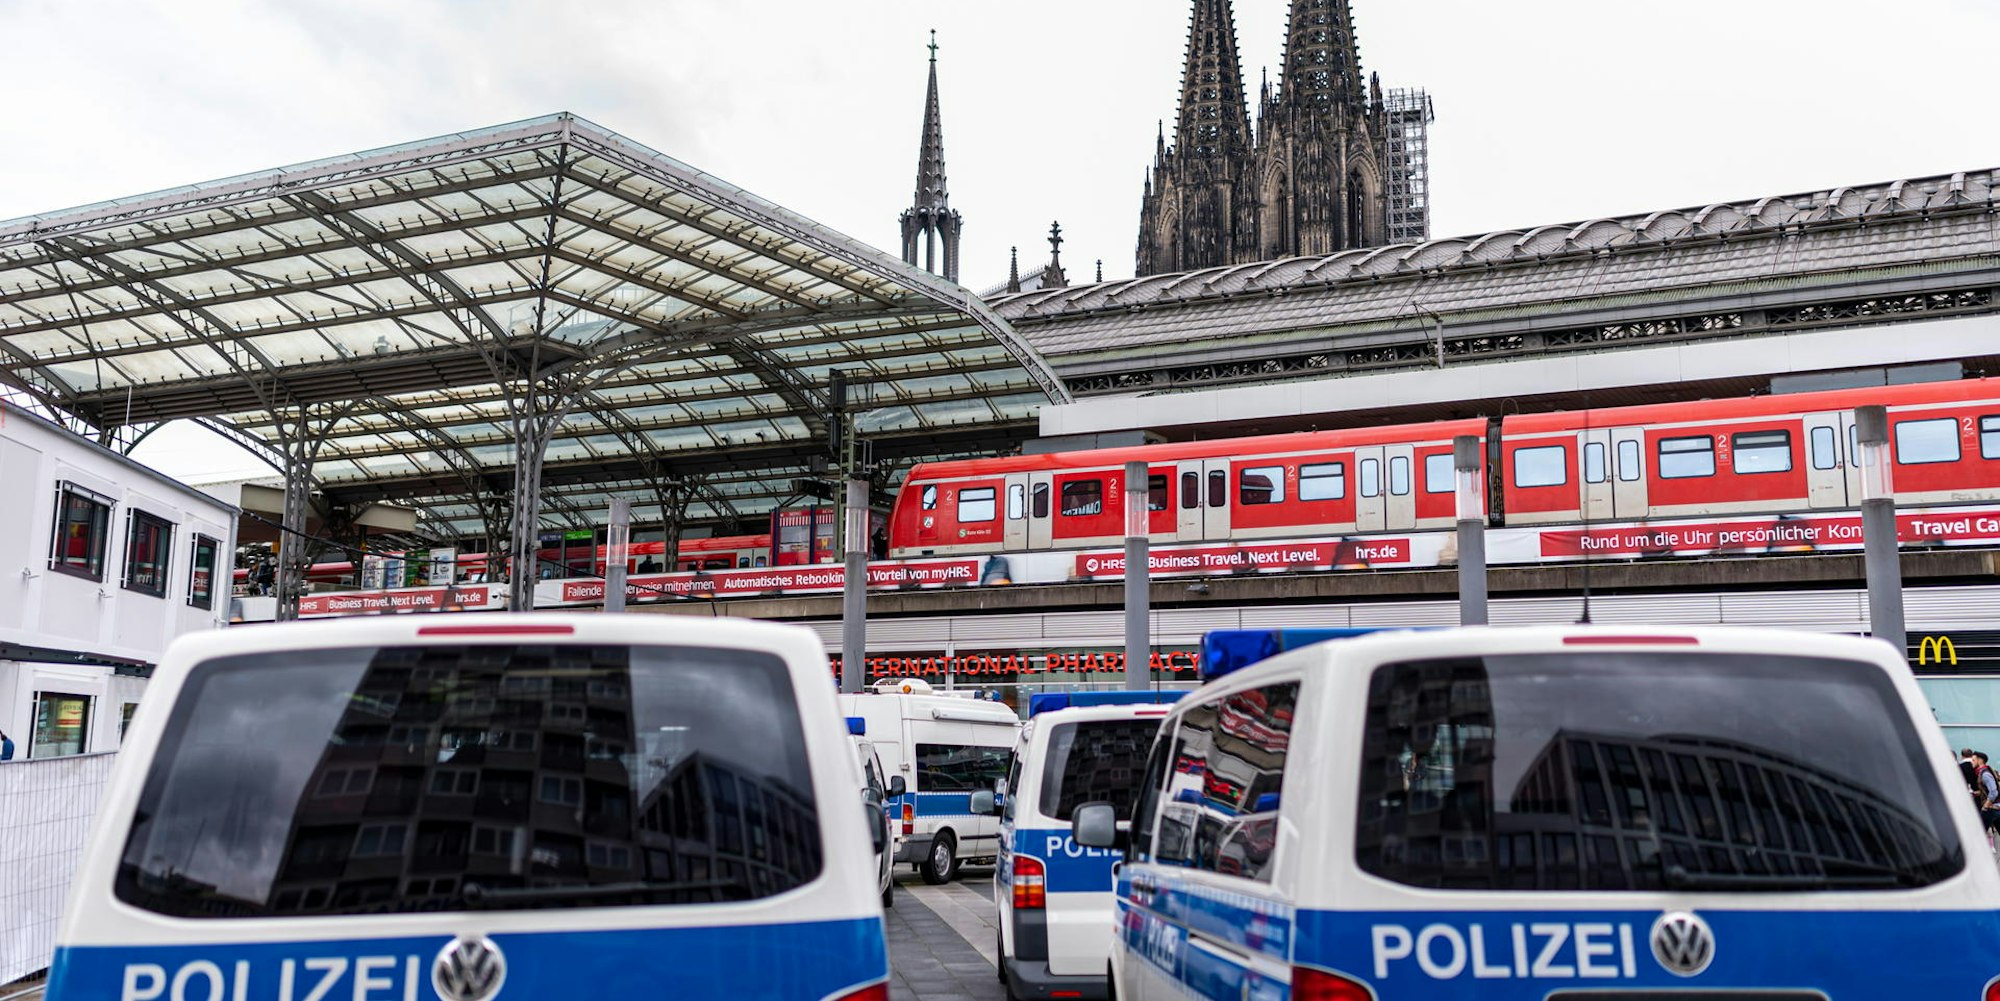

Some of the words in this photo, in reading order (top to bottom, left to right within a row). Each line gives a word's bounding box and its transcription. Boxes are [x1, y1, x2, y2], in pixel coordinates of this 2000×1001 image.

[1963, 417, 1973, 431] 2
[1718, 434, 1727, 448] 2
[1287, 465, 1295, 477] 2
[1109, 478, 1117, 490] 2
[946, 490, 953, 501] 2
[1580, 534, 1619, 549] Rund
[1625, 535, 1650, 547] um
[1654, 531, 1679, 546] die
[1683, 529, 1714, 545] Uhr
[1719, 523, 1821, 546] persönlicher
[1911, 519, 1970, 536] Travel
[1101, 559, 1126, 570] HRS
[1148, 554, 1199, 568] Business
[1203, 551, 1245, 566] Travel.
[1248, 551, 1279, 564] Next
[1282, 548, 1320, 562] Level.
[1355, 545, 1398, 559] hrs.de
[568, 585, 602, 597] Fallende
[664, 579, 717, 592] mitnehmen.
[724, 575, 793, 589] Automatisches
[796, 571, 845, 585] Rebookin
[873, 568, 907, 581] Vorteil
[909, 569, 929, 579] von
[931, 566, 973, 580] myHRS.
[300, 601, 317, 610] HRS
[329, 599, 362, 609] Business
[363, 597, 389, 608] Travel.
[391, 596, 410, 606] Next
[411, 594, 435, 605] Level.
[455, 592, 481, 603] hrs.de
[832, 655, 1035, 677] IERNATIONAL
[1047, 650, 1200, 673] PHARACY
[1371, 923, 1637, 979] POLIZEI
